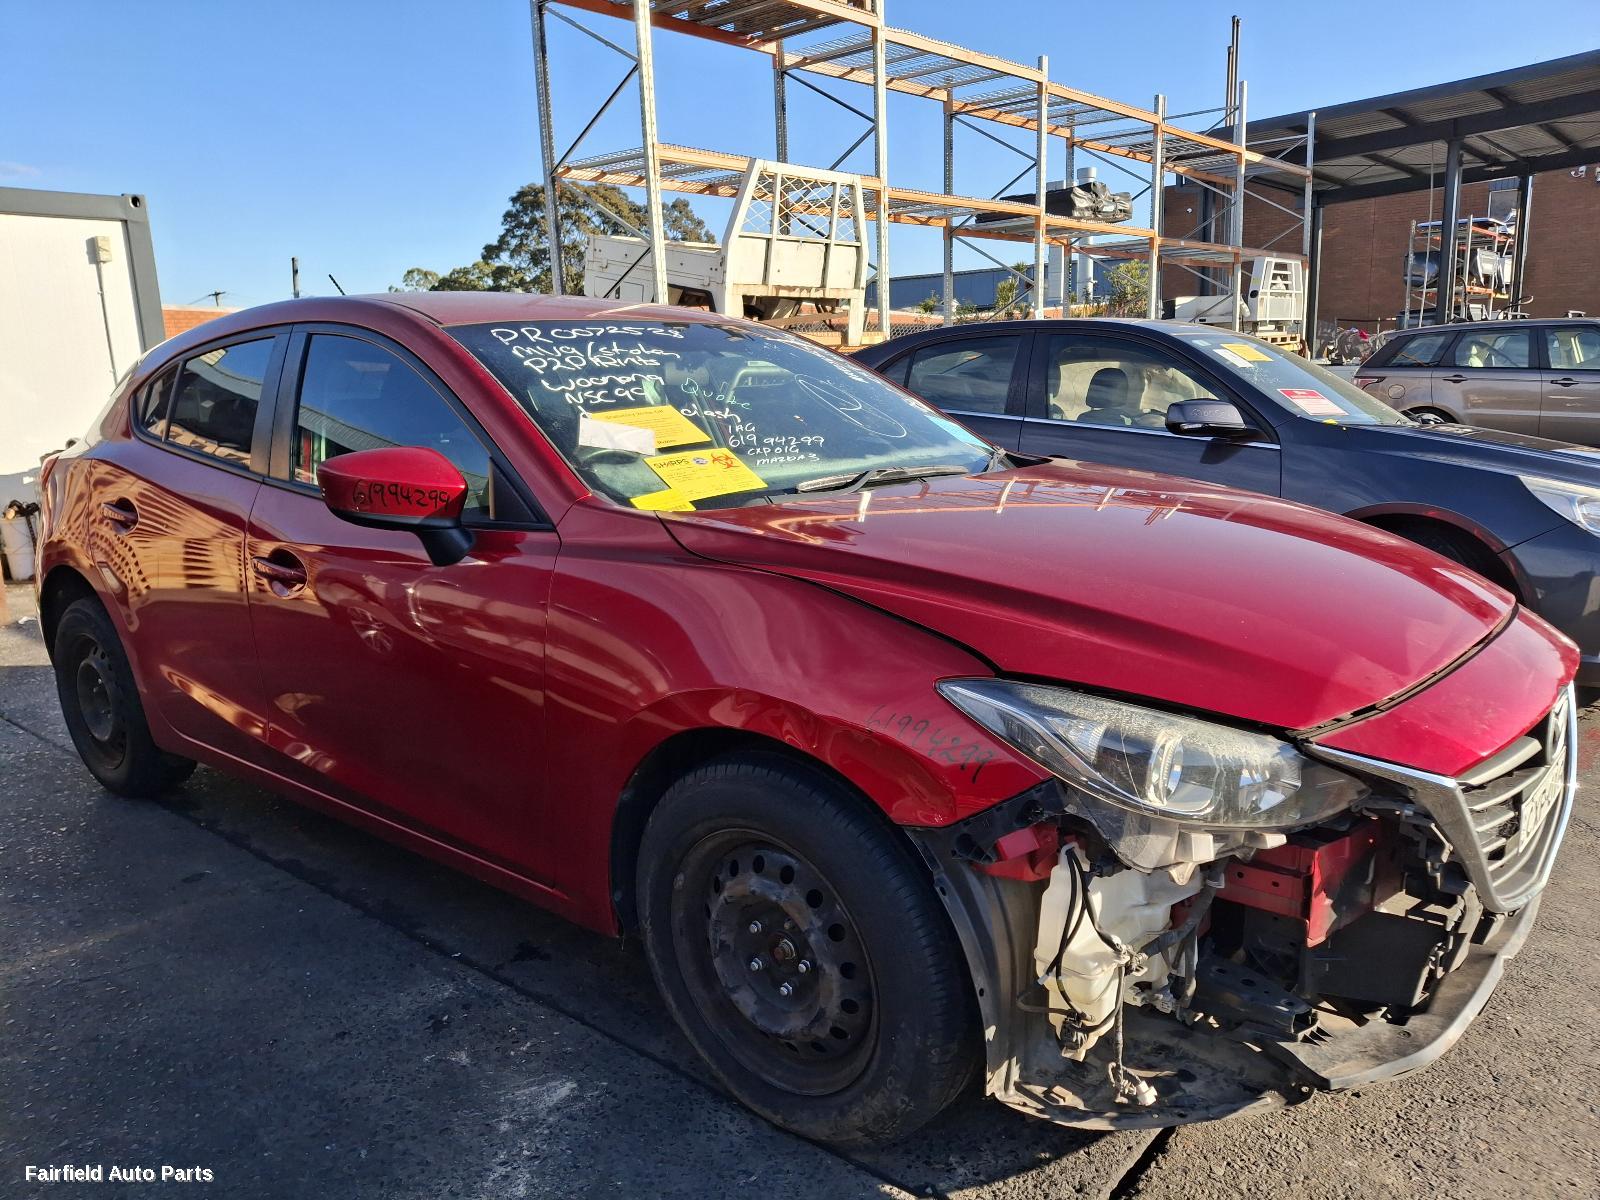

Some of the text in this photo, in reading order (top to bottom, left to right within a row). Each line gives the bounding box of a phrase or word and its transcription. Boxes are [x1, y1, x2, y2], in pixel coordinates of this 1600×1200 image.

[728, 433, 826, 448] 619 94299
[352, 478, 450, 512] 61994299
